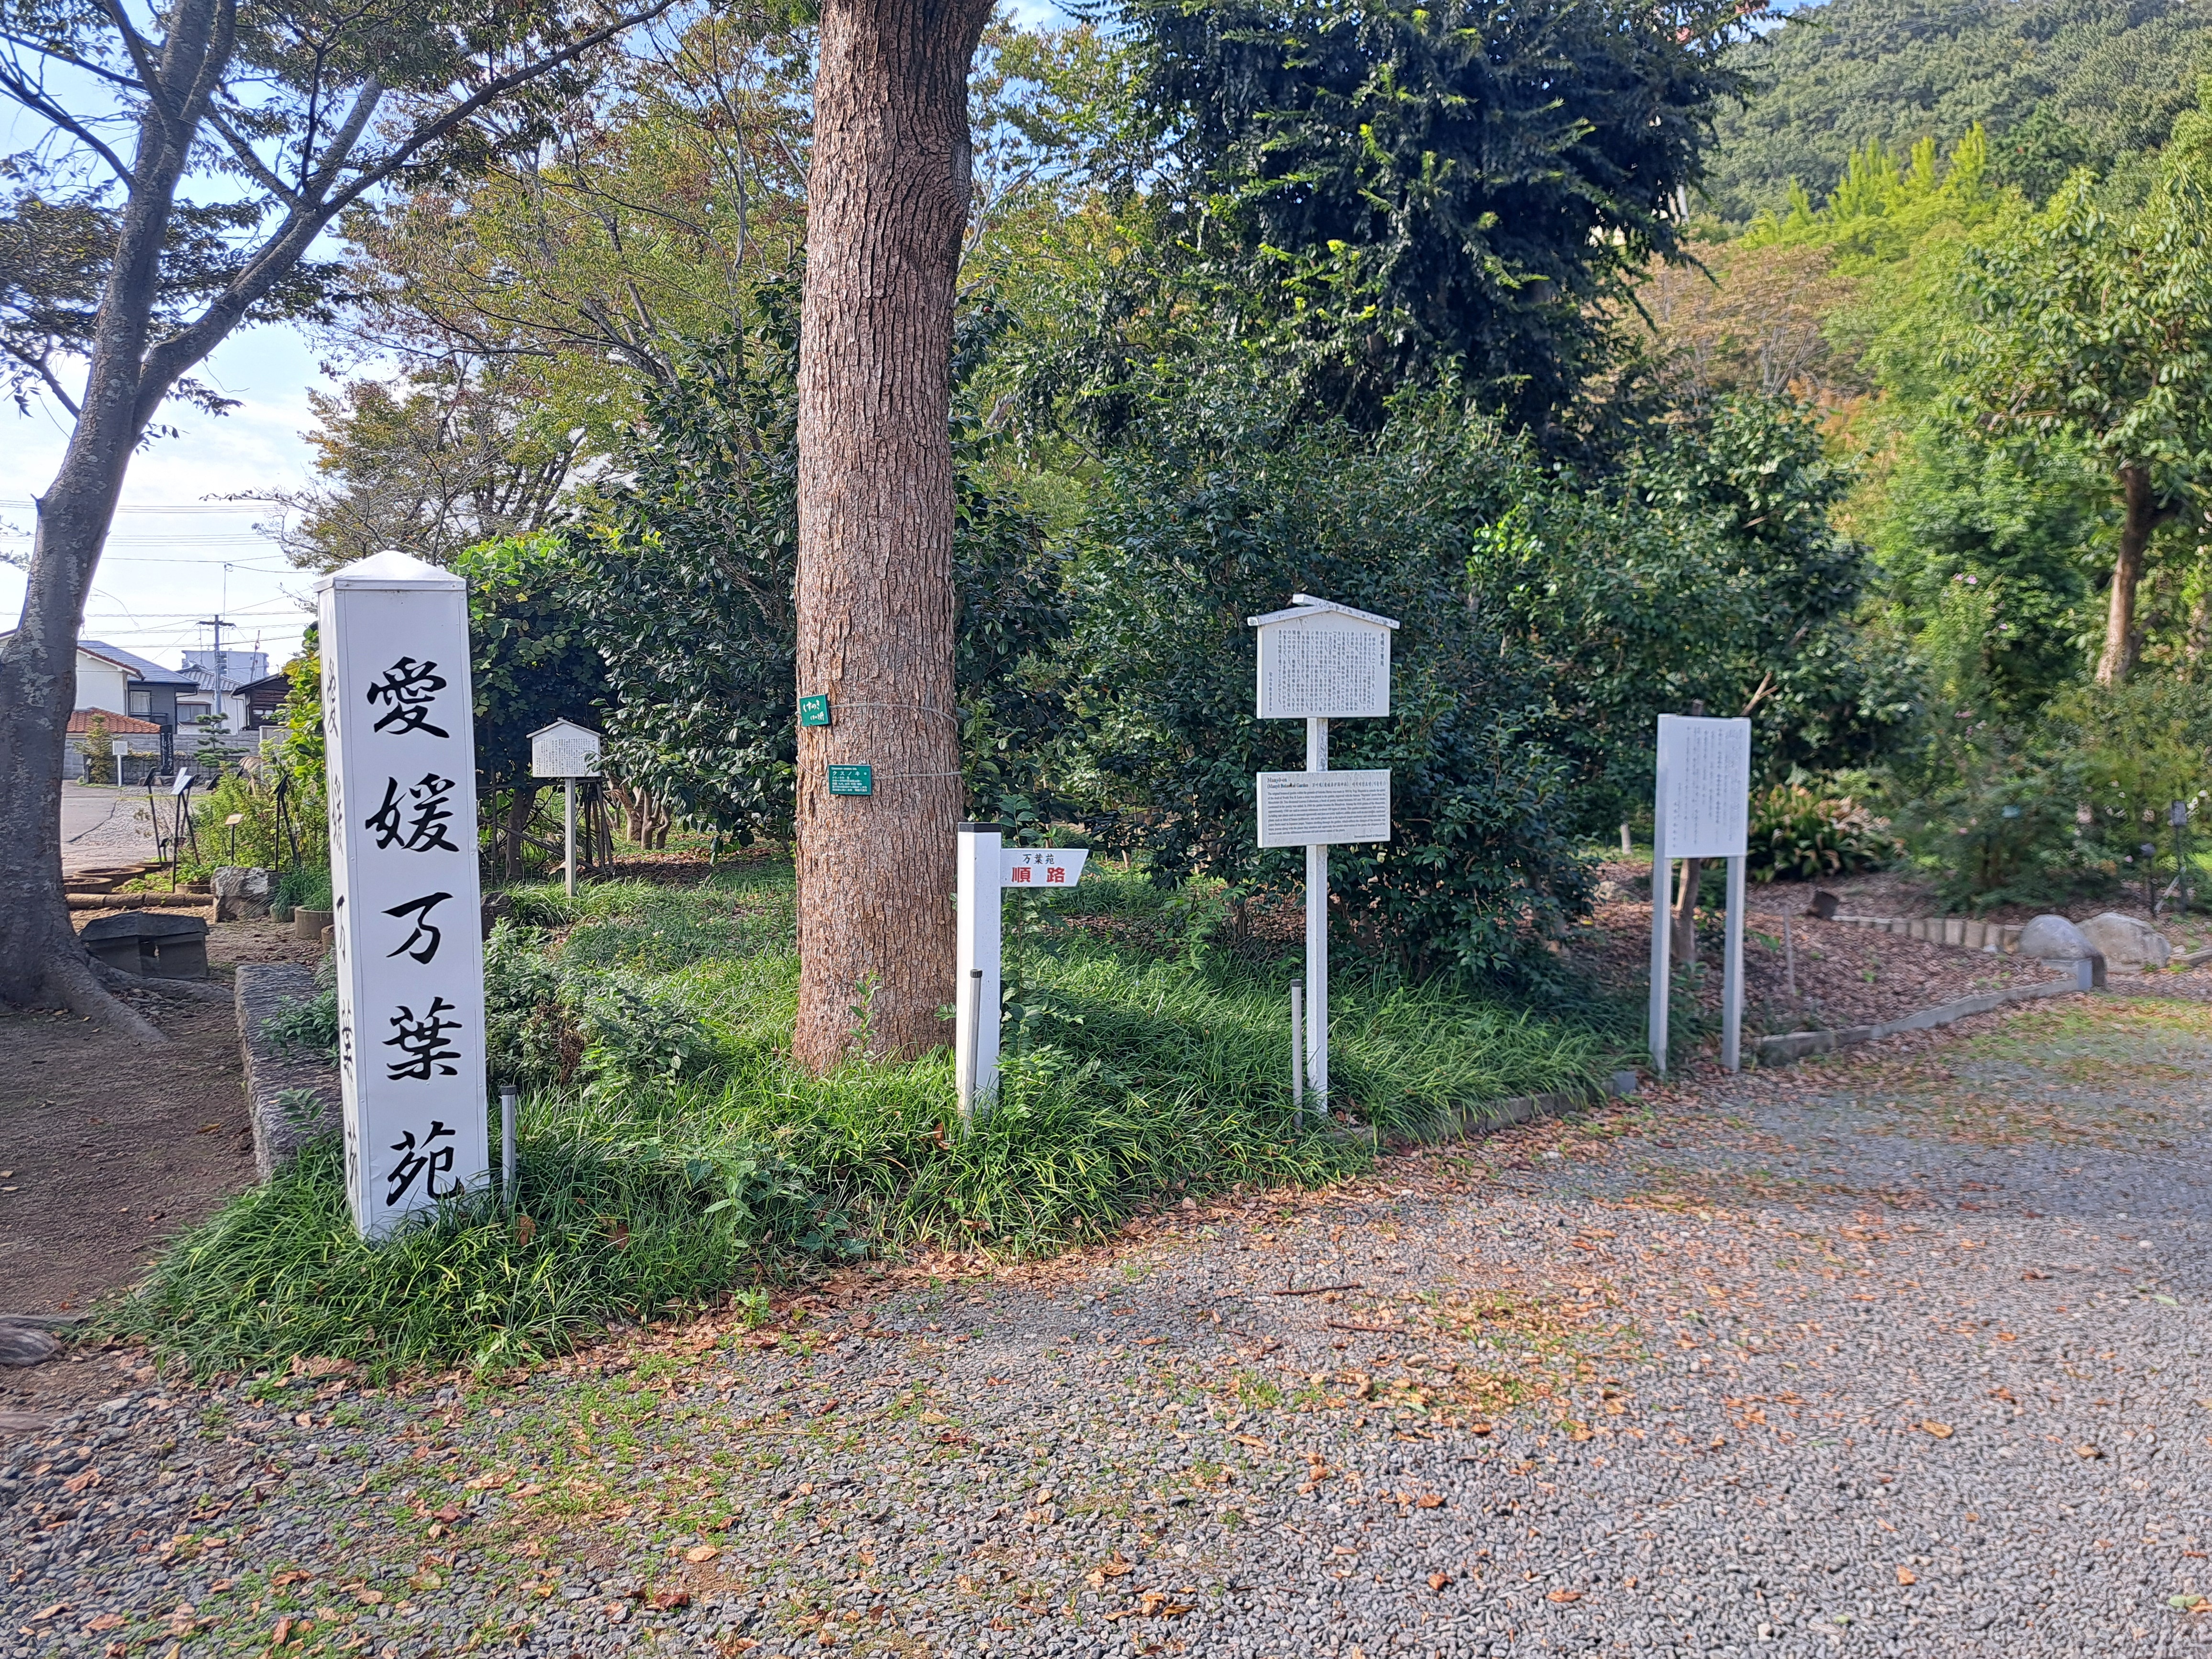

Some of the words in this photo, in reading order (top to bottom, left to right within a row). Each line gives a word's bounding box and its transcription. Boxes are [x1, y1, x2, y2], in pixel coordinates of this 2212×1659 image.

[1022, 853, 1055, 864] 万葉苑
[1011, 867, 1065, 883] 順路
[365, 656, 465, 1206] 愛媛万葉苑
